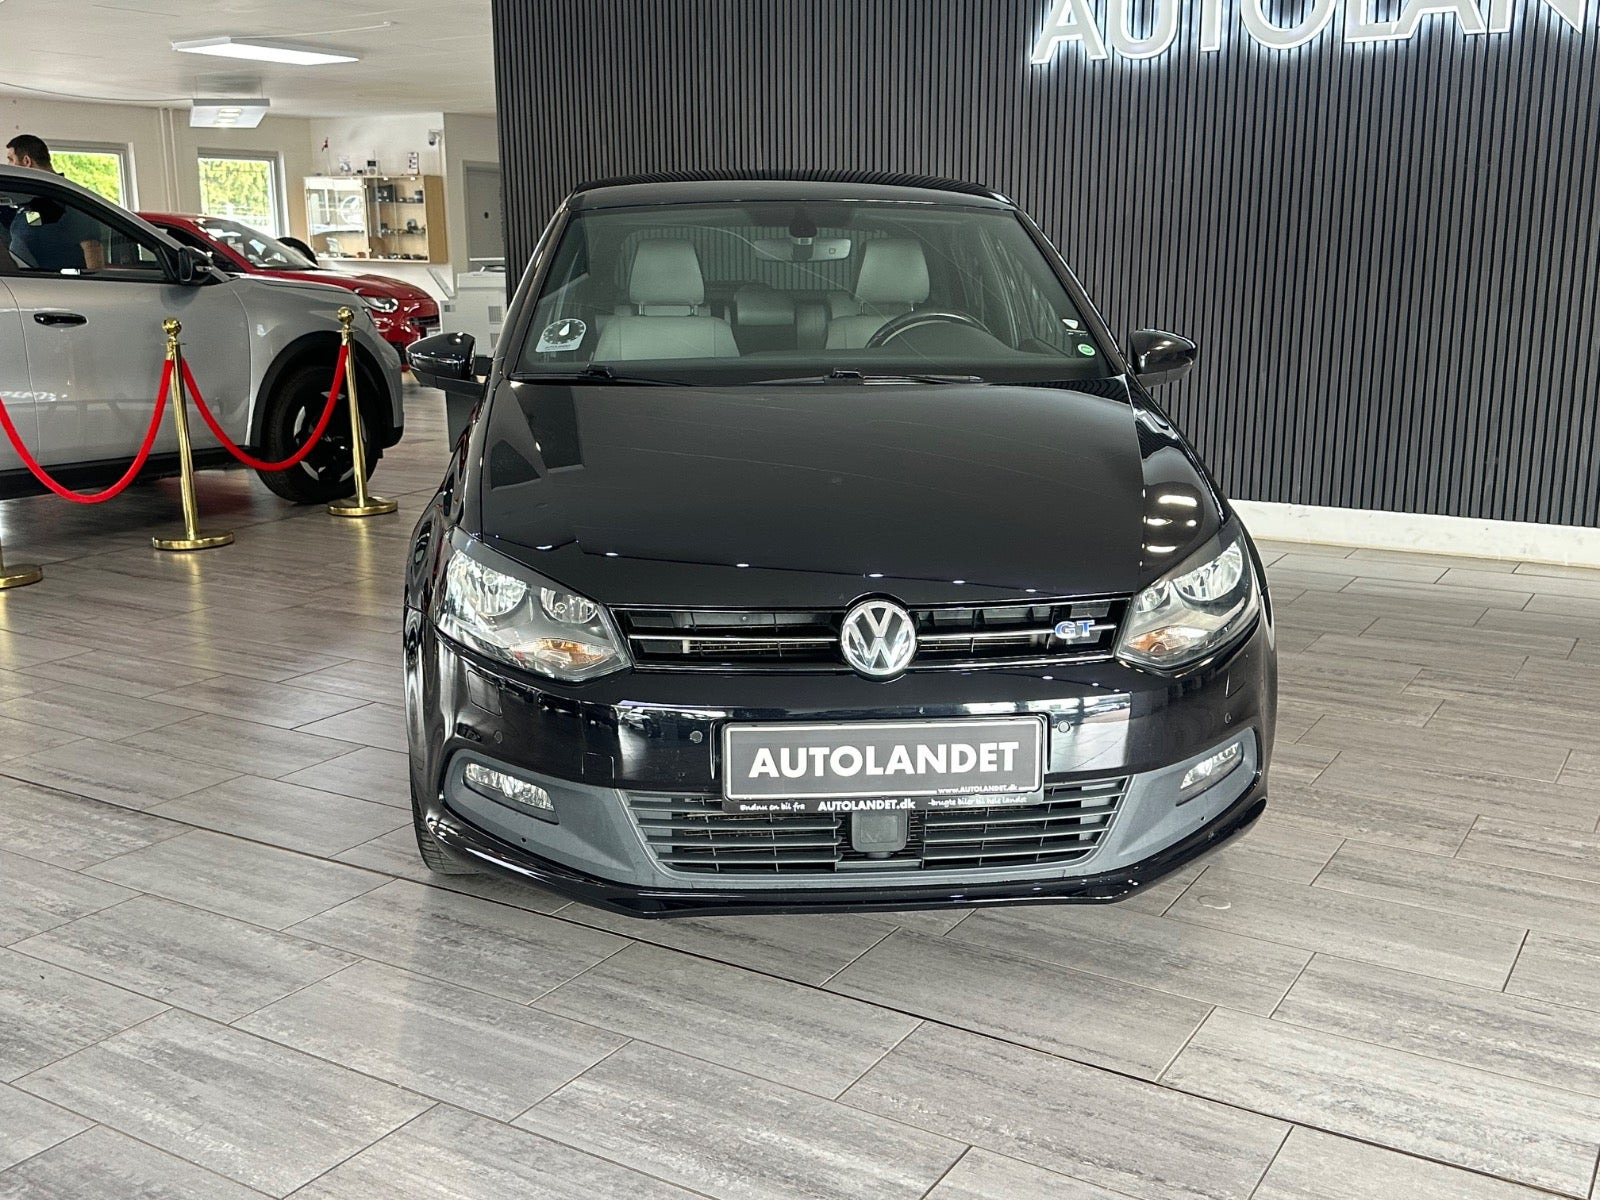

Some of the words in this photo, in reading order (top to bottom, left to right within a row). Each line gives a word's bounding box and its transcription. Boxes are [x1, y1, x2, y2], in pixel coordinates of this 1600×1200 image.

[842, 601, 916, 675] VW
[1055, 620, 1095, 639] GT
[748, 741, 1019, 778] AUTOLANDET
[938, 784, 1017, 794] www.AUTOLANDET.dk
[817, 798, 916, 812] AUTOLANDET.dk
